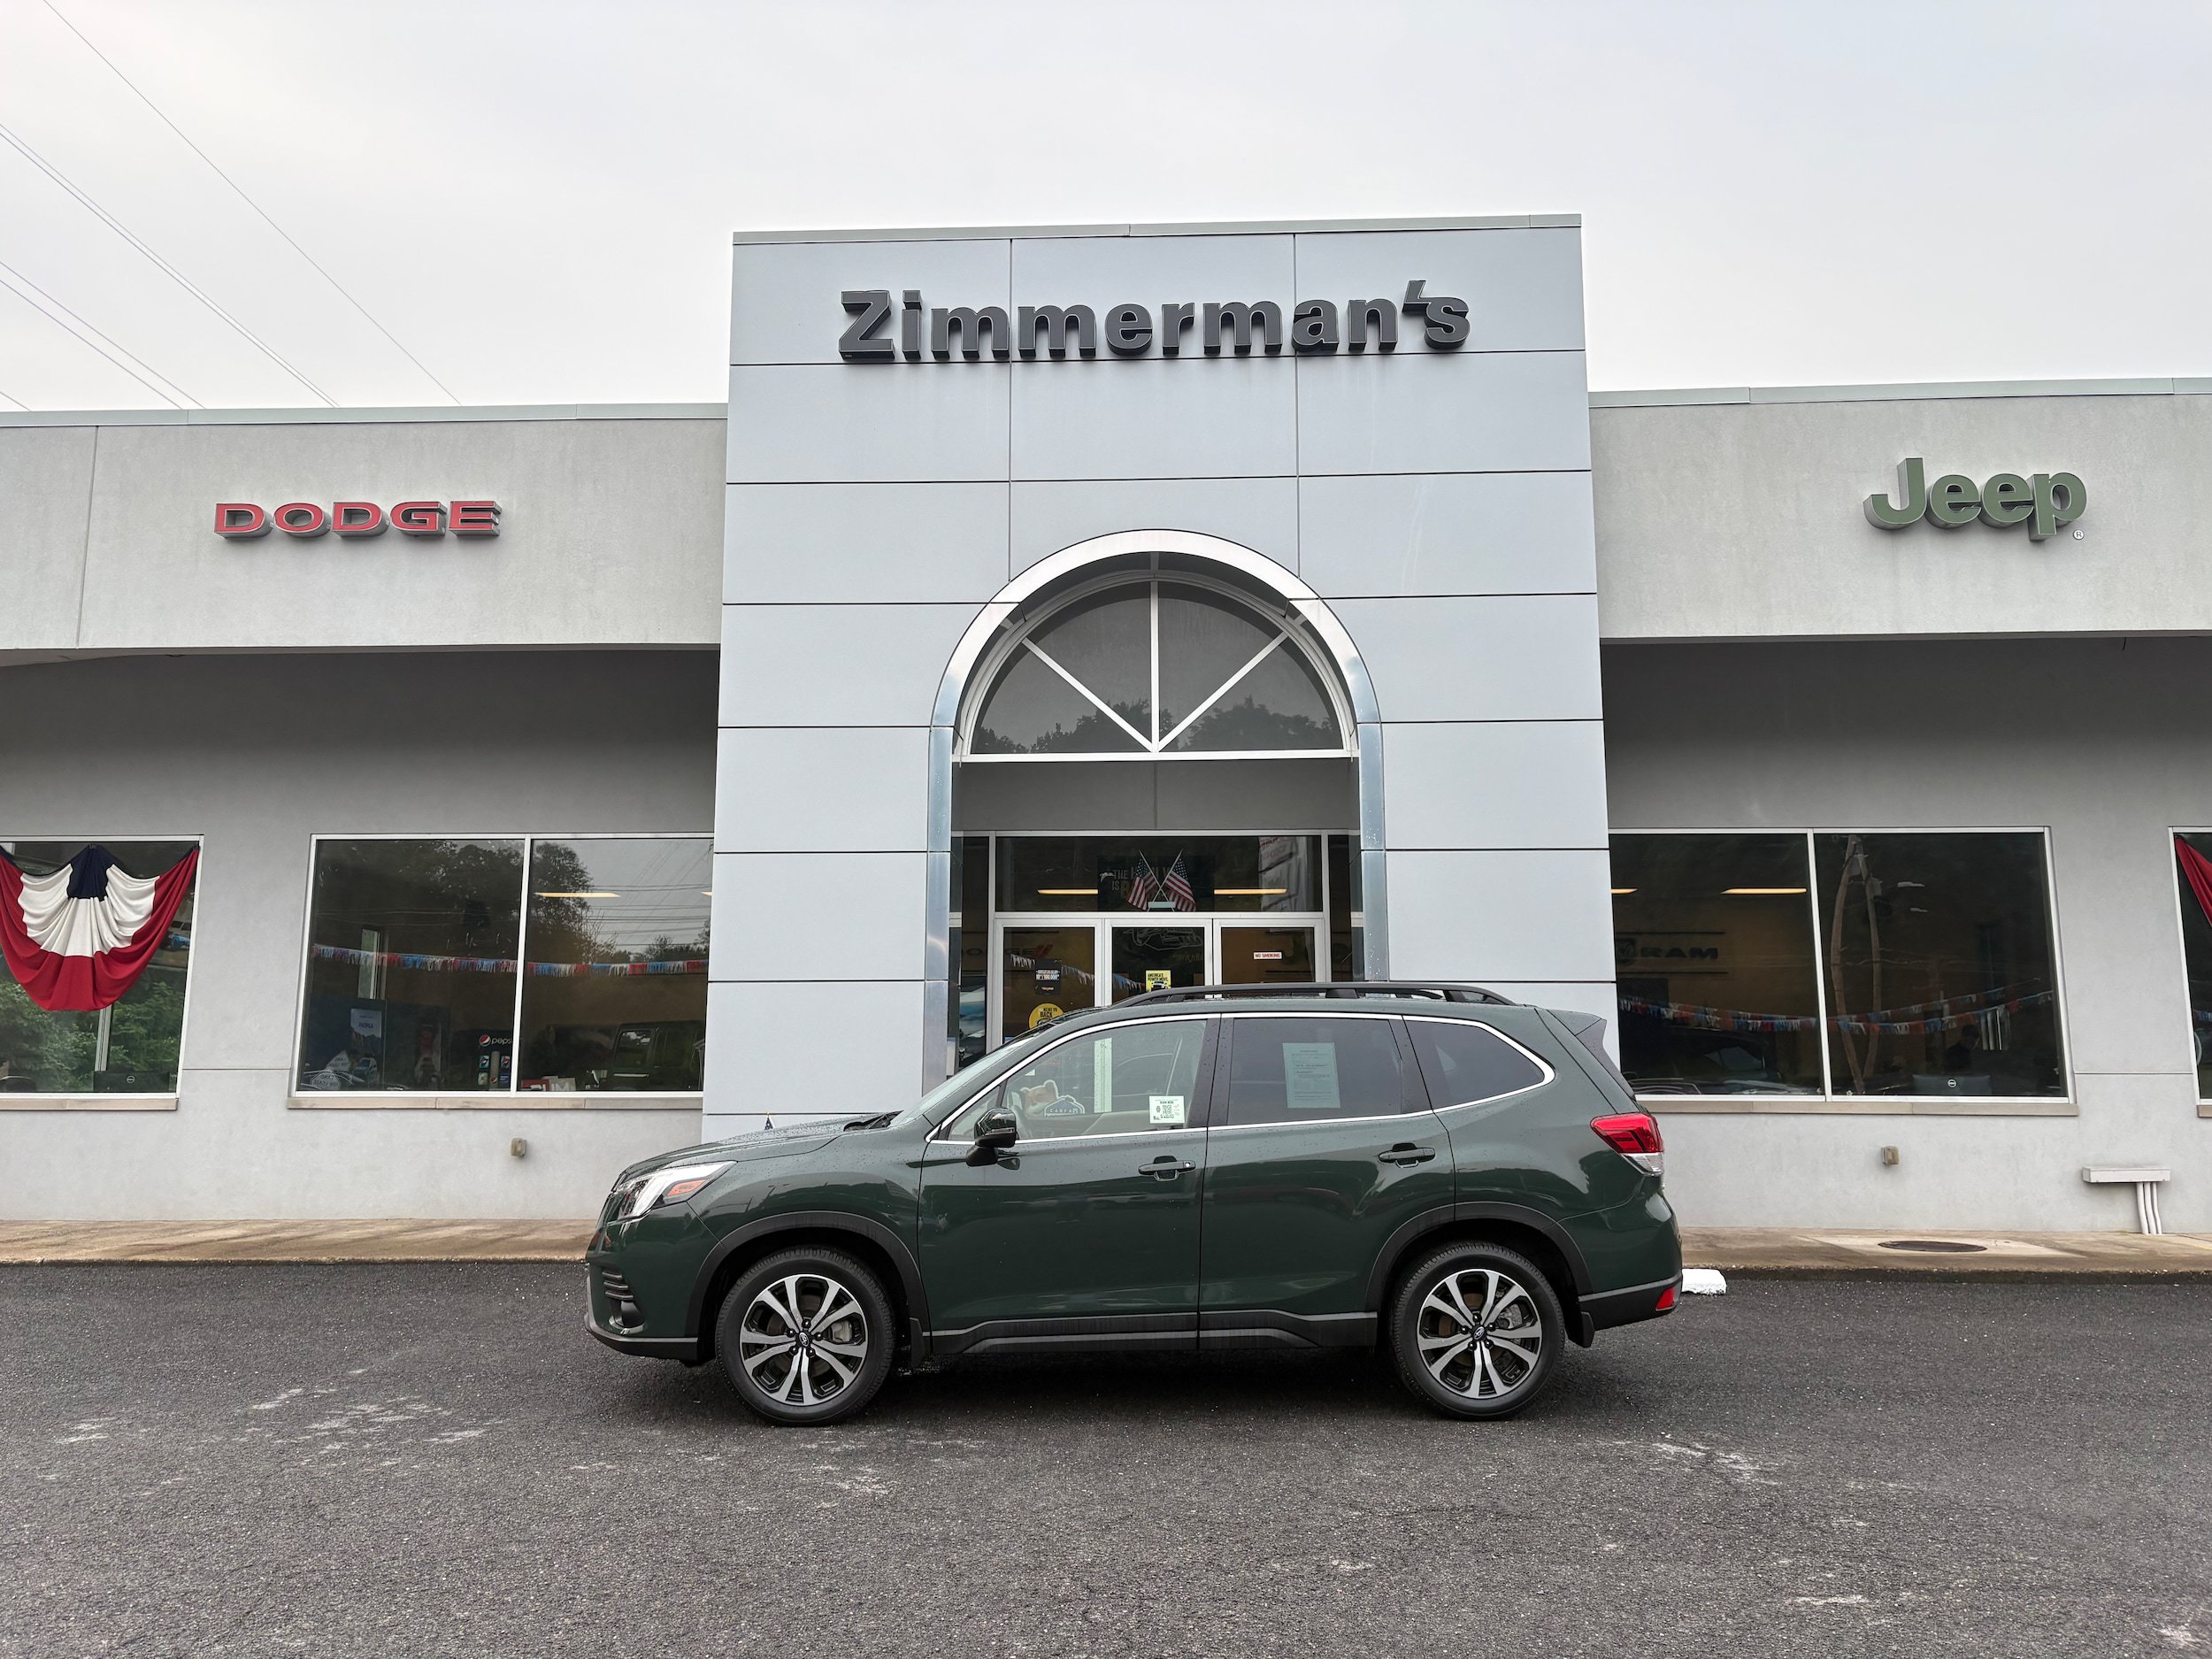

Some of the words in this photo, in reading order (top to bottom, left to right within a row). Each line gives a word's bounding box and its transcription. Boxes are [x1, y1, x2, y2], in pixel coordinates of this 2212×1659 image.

[839, 280, 1471, 361] Zimmerman's
[214, 501, 502, 539] DODGE
[1863, 457, 2087, 541] Jeep
[1640, 947, 1718, 959] RAM
